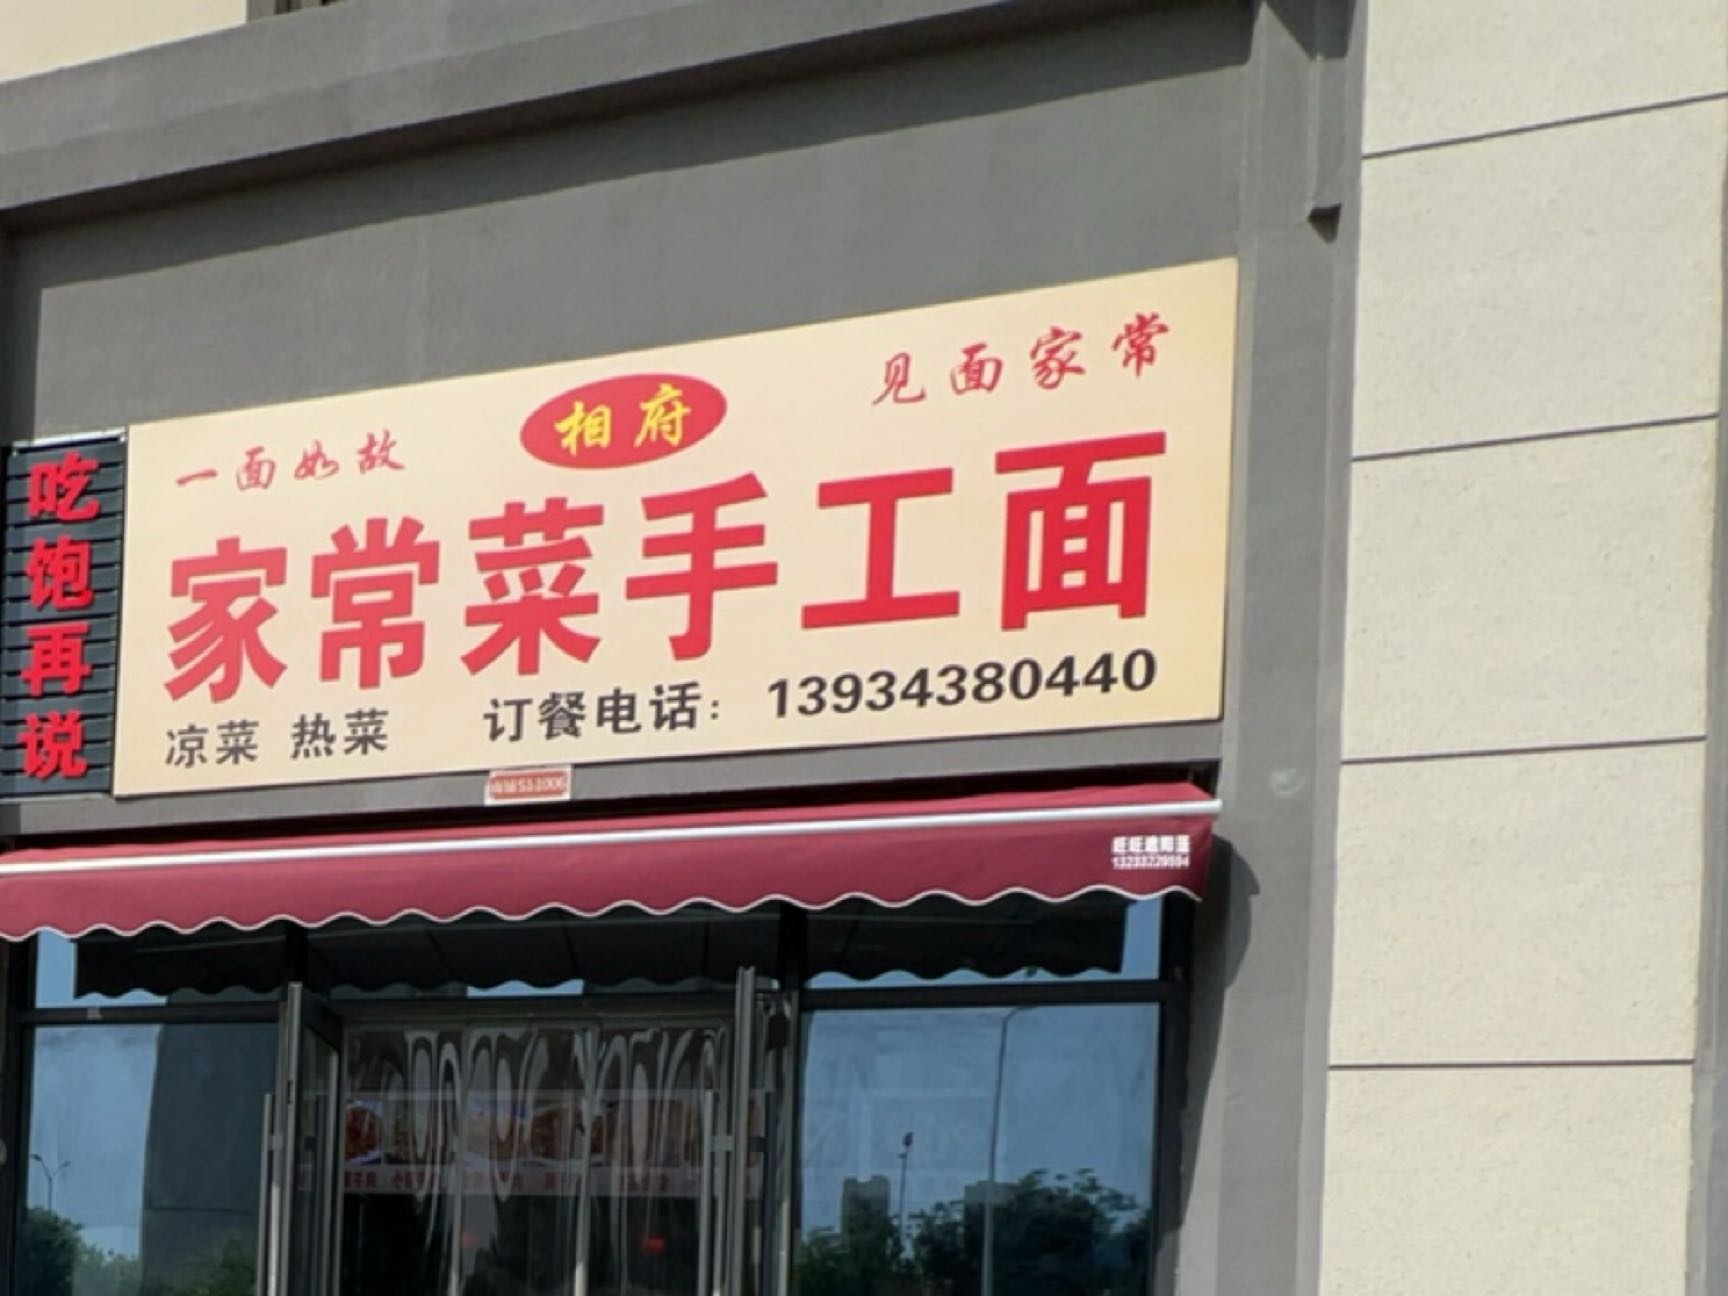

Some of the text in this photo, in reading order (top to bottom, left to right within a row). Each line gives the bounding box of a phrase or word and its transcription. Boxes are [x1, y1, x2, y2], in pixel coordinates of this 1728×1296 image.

[871, 312, 1170, 408] 见面家常
[175, 429, 406, 492] 一面如故
[553, 383, 693, 454] 相府
[18, 450, 100, 782] 吃饱再说
[162, 430, 1168, 704] 家常菜手工面
[164, 647, 1158, 768] 凉菜 热菜 订餐电话： 13934380440
